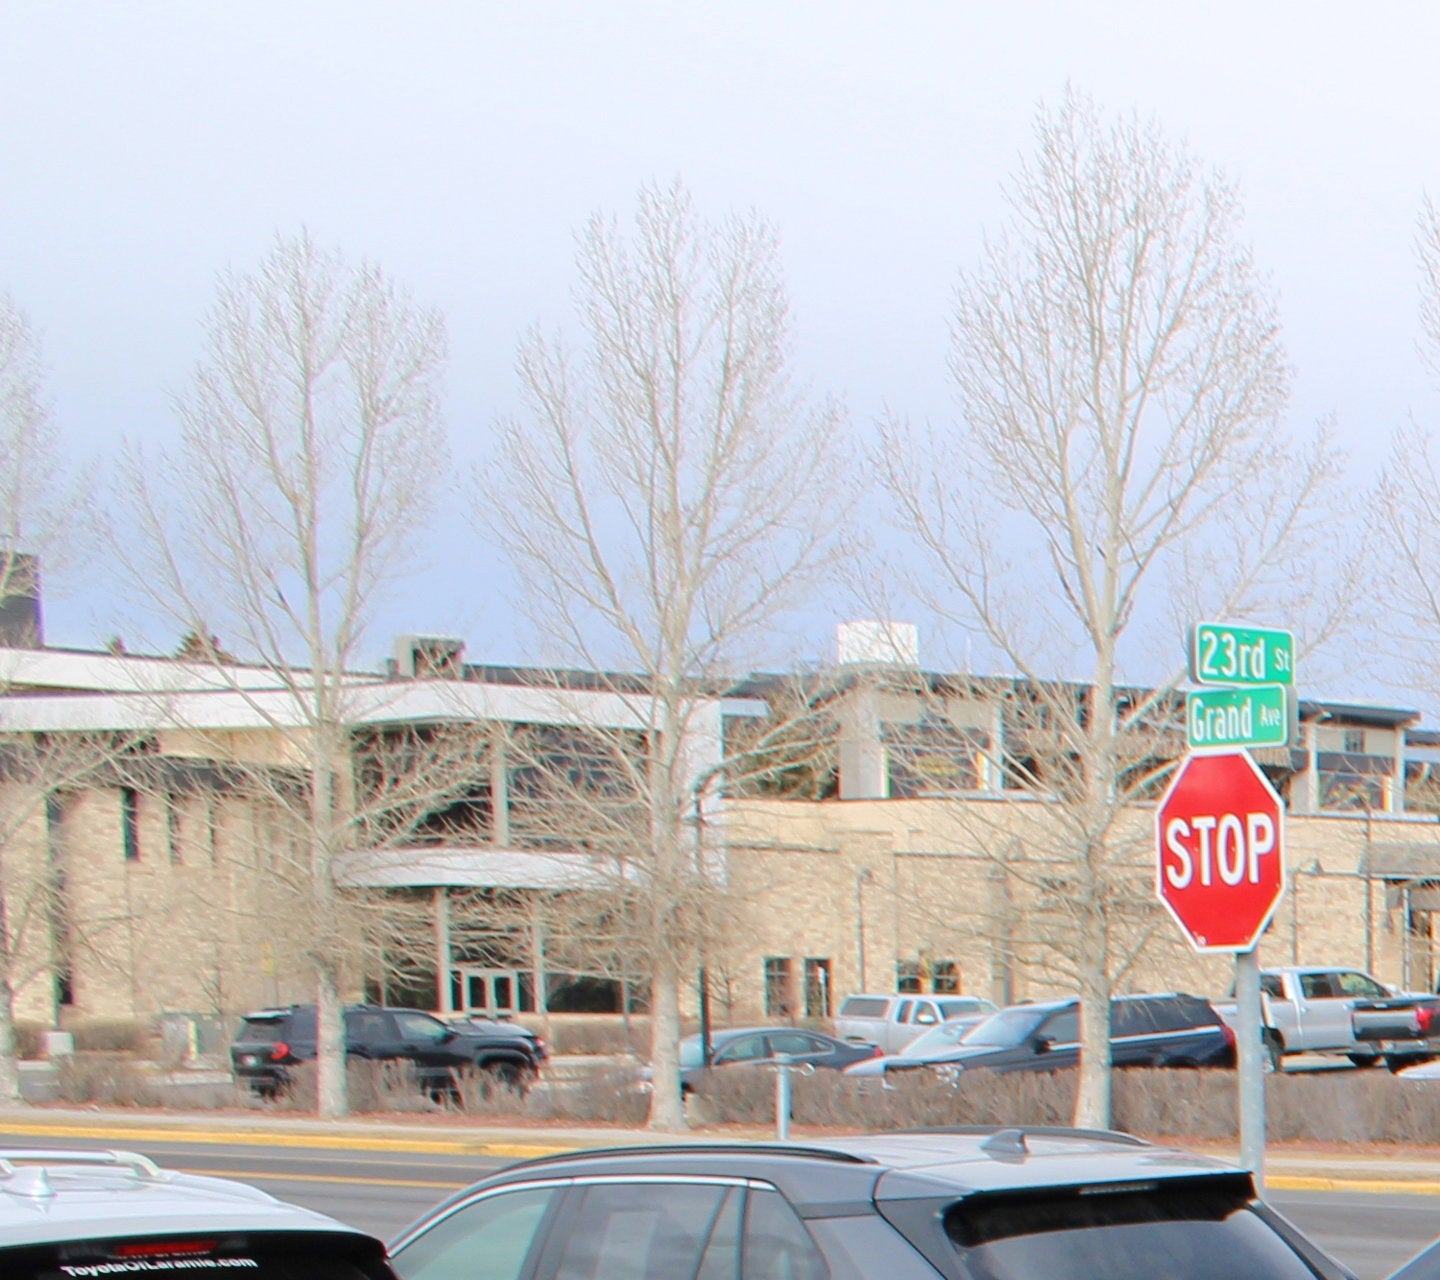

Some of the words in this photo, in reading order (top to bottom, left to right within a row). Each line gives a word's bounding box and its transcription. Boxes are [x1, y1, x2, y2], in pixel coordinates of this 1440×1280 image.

[1201, 630, 1267, 680] 23rd
[1274, 647, 1291, 672] St
[1191, 697, 1254, 742] Grand
[1259, 704, 1281, 727] Ave
[1165, 811, 1275, 890] STOP
